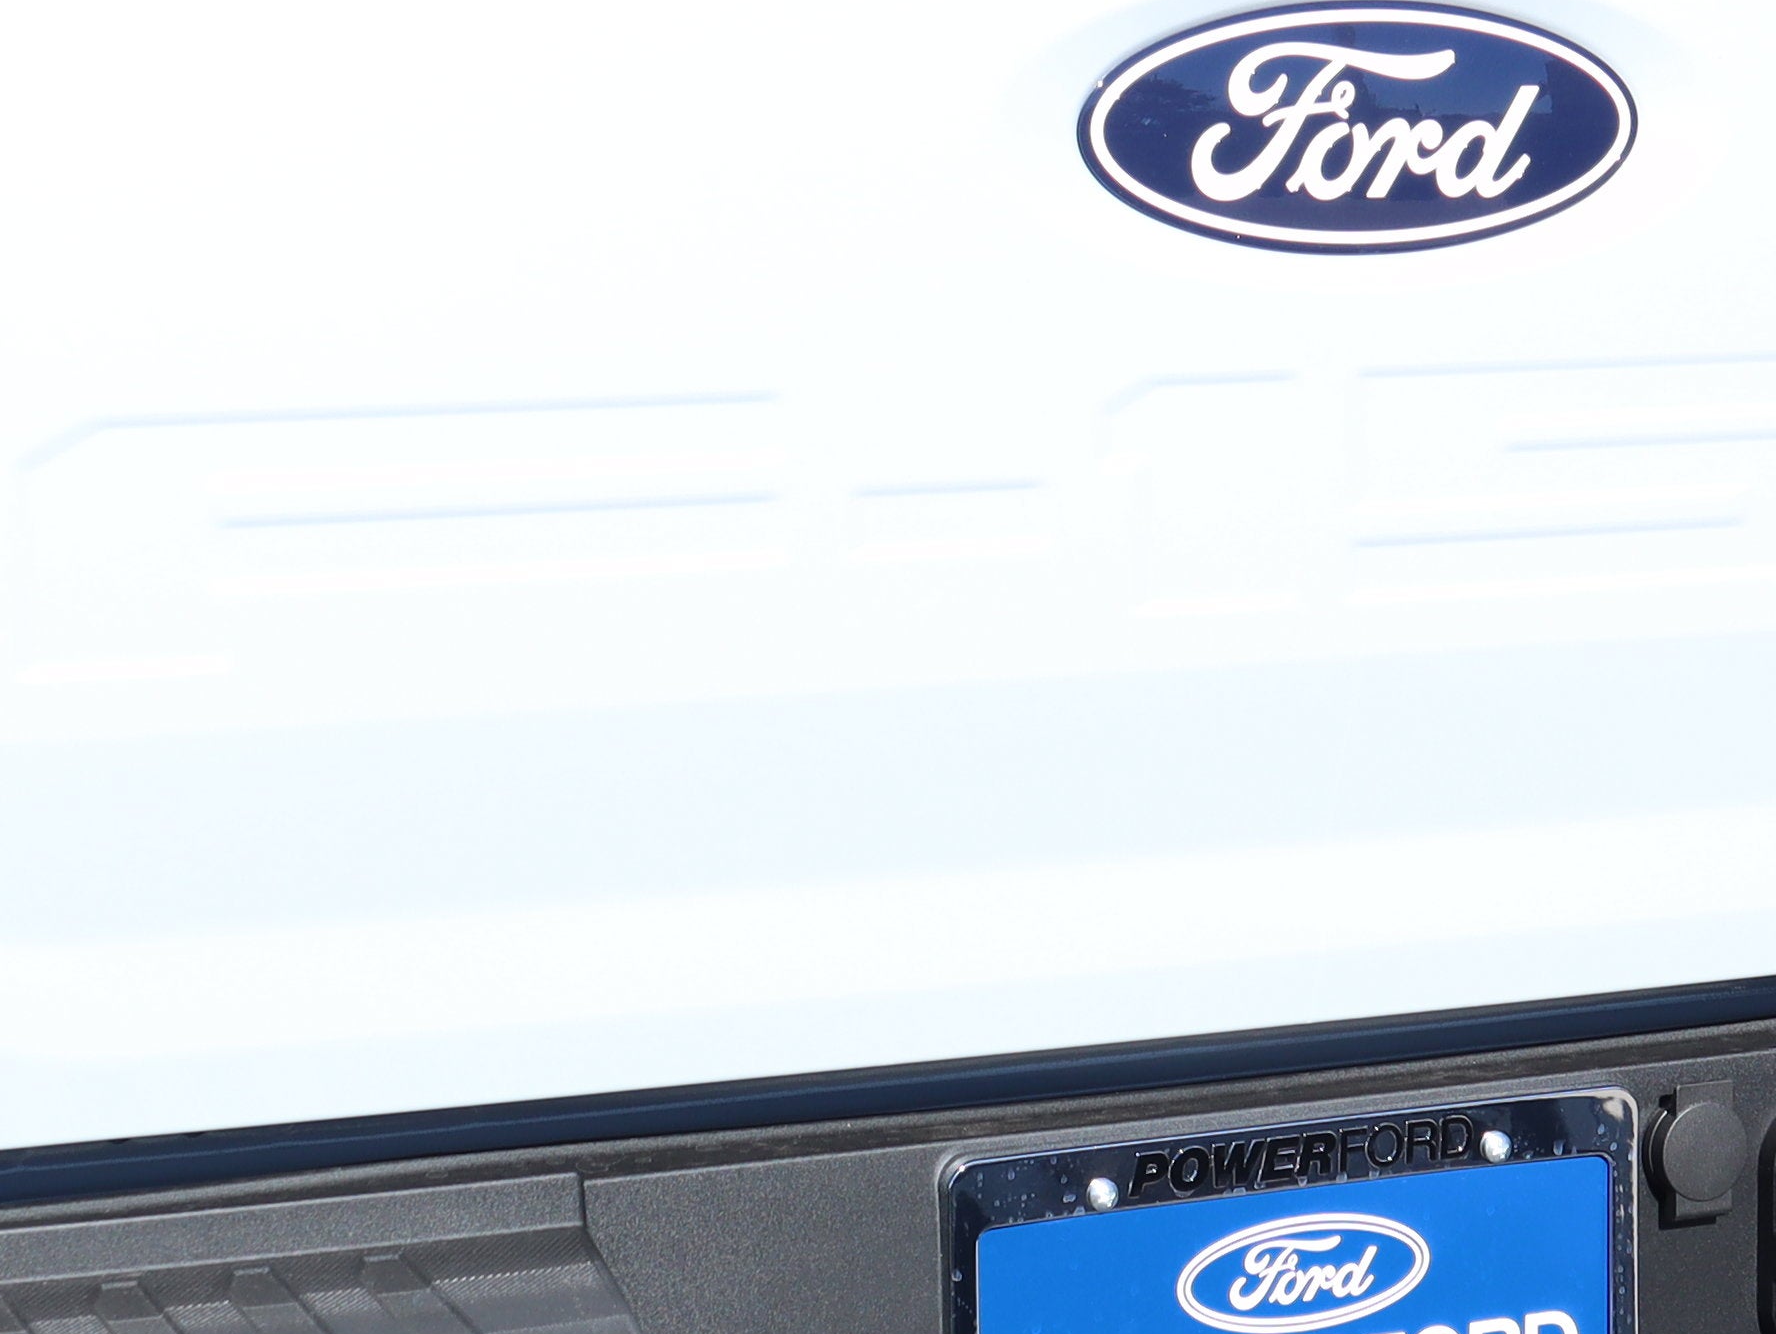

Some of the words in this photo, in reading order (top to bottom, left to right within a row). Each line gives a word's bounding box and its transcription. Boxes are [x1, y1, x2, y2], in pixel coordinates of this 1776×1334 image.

[1191, 41, 1540, 202] Ford
[1128, 1115, 1475, 1198] POWERFORD
[1228, 1233, 1379, 1312] Ford
